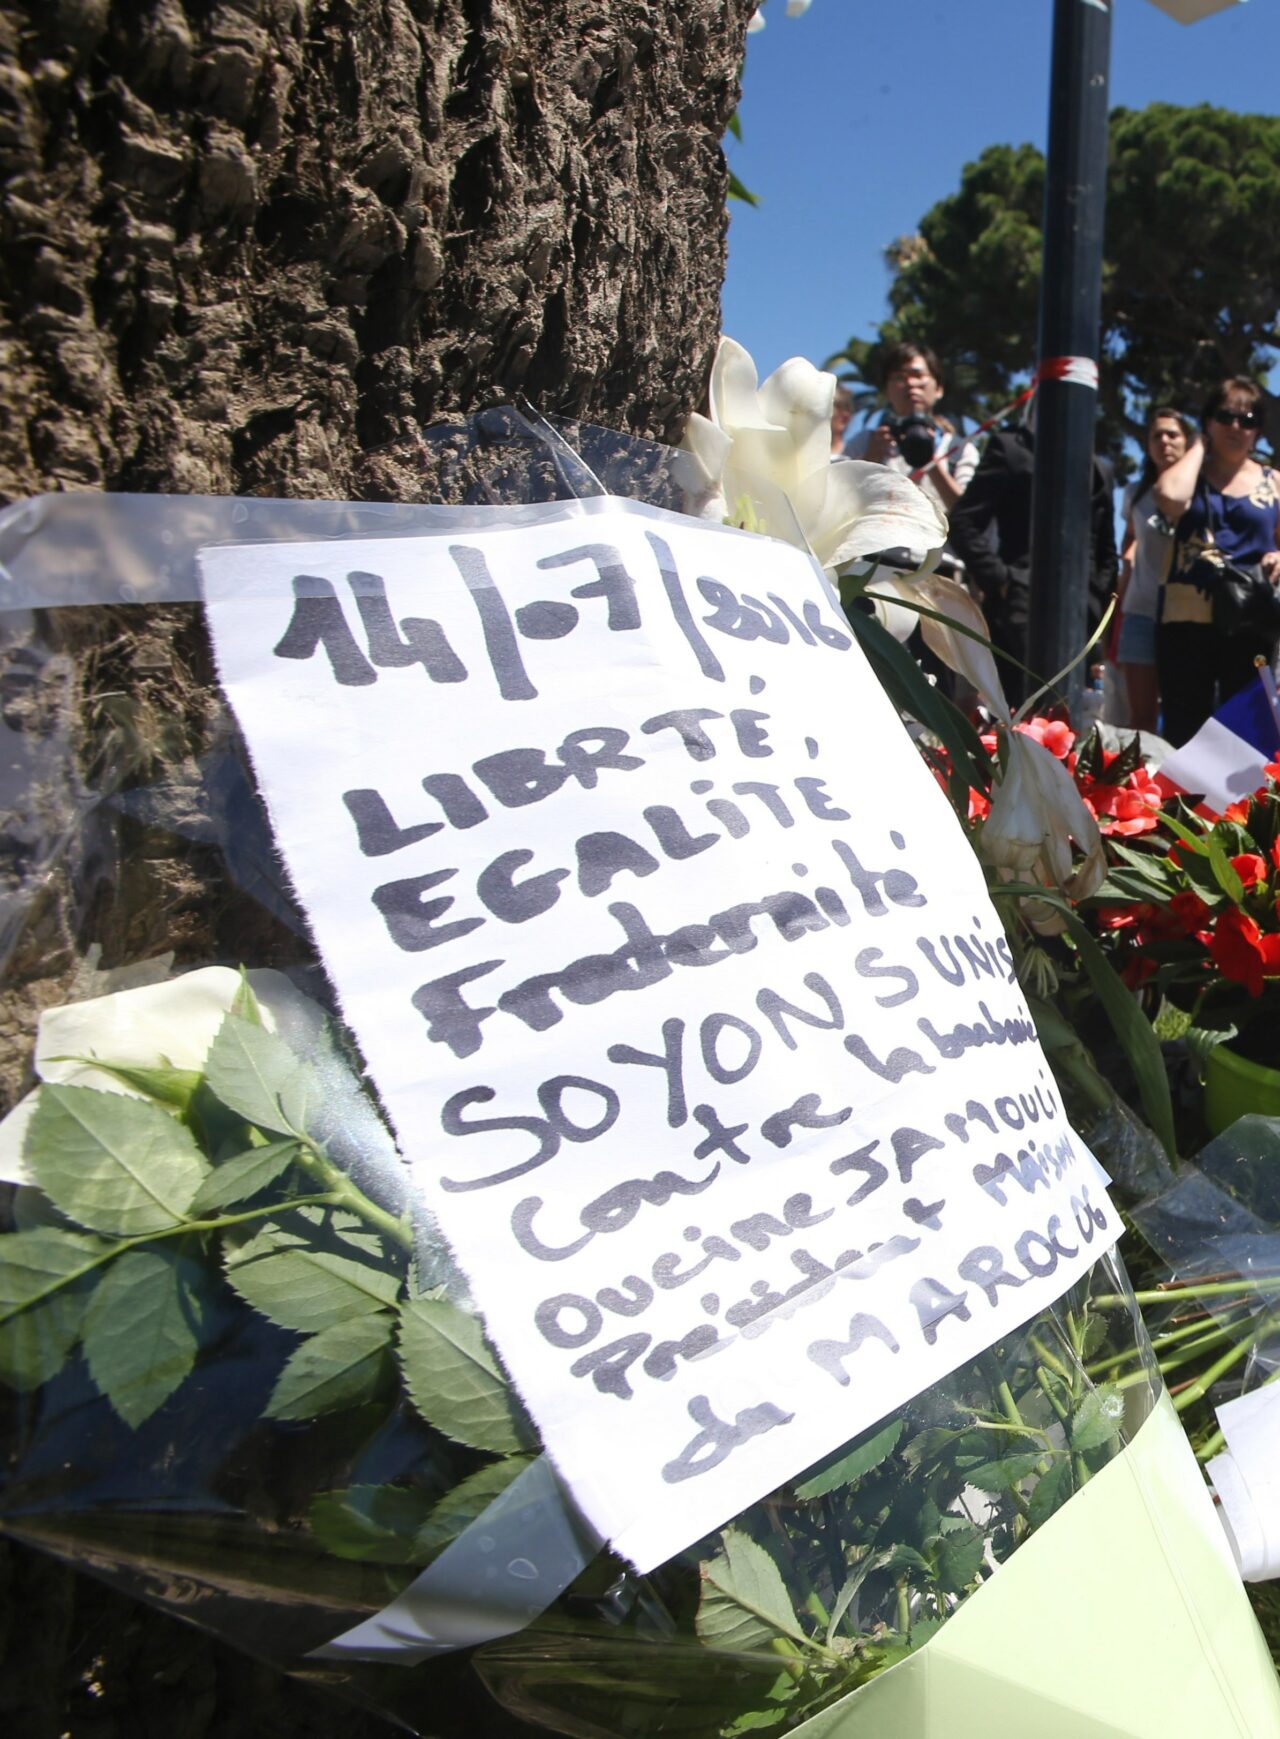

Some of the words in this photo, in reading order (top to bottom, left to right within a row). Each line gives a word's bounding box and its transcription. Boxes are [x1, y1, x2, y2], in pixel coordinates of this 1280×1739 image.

[273, 530, 852, 701] 14/07/2016
[441, 946, 919, 1192] SOYONS
[511, 1093, 853, 1262] Contre
[843, 1033, 937, 1084] la
[806, 1214, 1079, 1387] MAROC
[1070, 1184, 1108, 1243] 06
